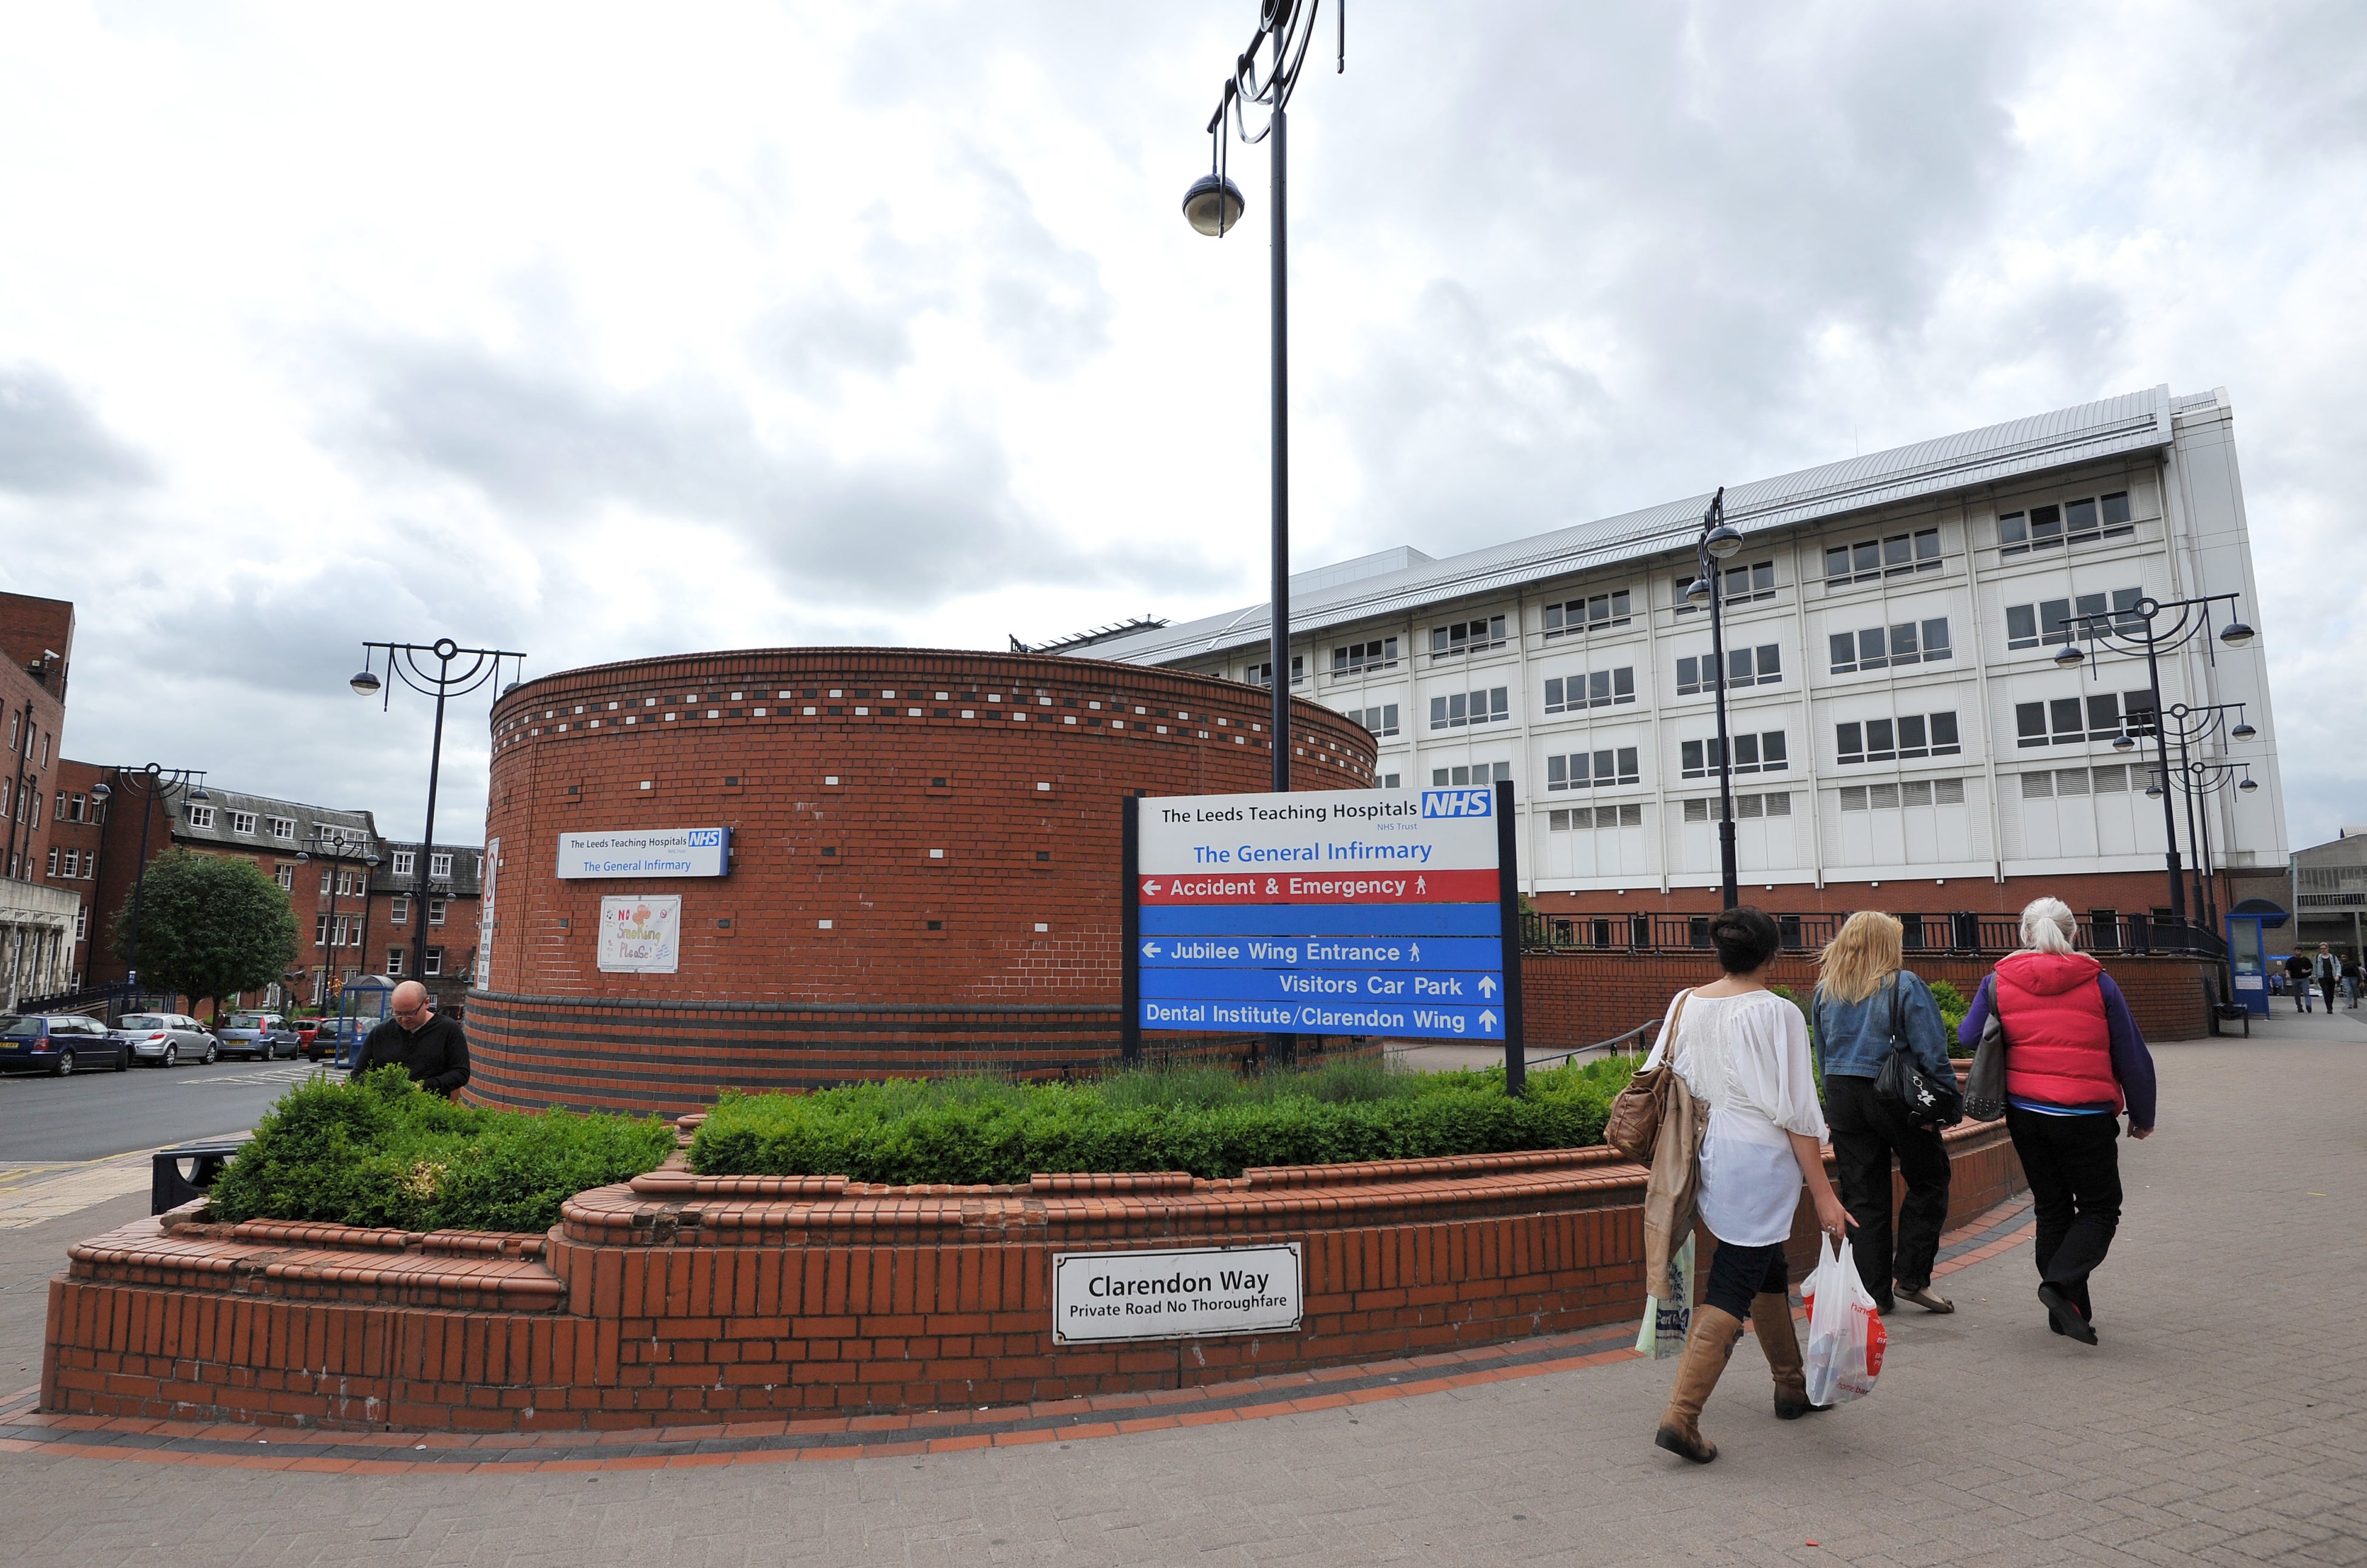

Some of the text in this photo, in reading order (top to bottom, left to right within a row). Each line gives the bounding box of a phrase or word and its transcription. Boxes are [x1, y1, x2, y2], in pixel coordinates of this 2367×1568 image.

[1162, 800, 1417, 823] The Leeds Teaching Hospitals
[1424, 791, 1489, 816] NHS
[1397, 822, 1418, 830] Trust
[571, 836, 687, 849] The Leeds Teaching Hospitals
[689, 831, 719, 846] NHS
[1193, 840, 1432, 863] The General Infirmary
[583, 859, 692, 872] The General Infirmary
[1170, 877, 1406, 897] Accident & Emergency
[618, 908, 631, 921] NO
[1171, 942, 1401, 964] Jubilee Wing Entrance
[1279, 975, 1463, 996] Visitors Car Park
[1146, 1004, 1465, 1033] Dental Institute/Clarendon Wing
[1088, 1270, 1269, 1297] Clarendon Way
[1070, 1294, 1288, 1317] Private Road No Thoroughfare
